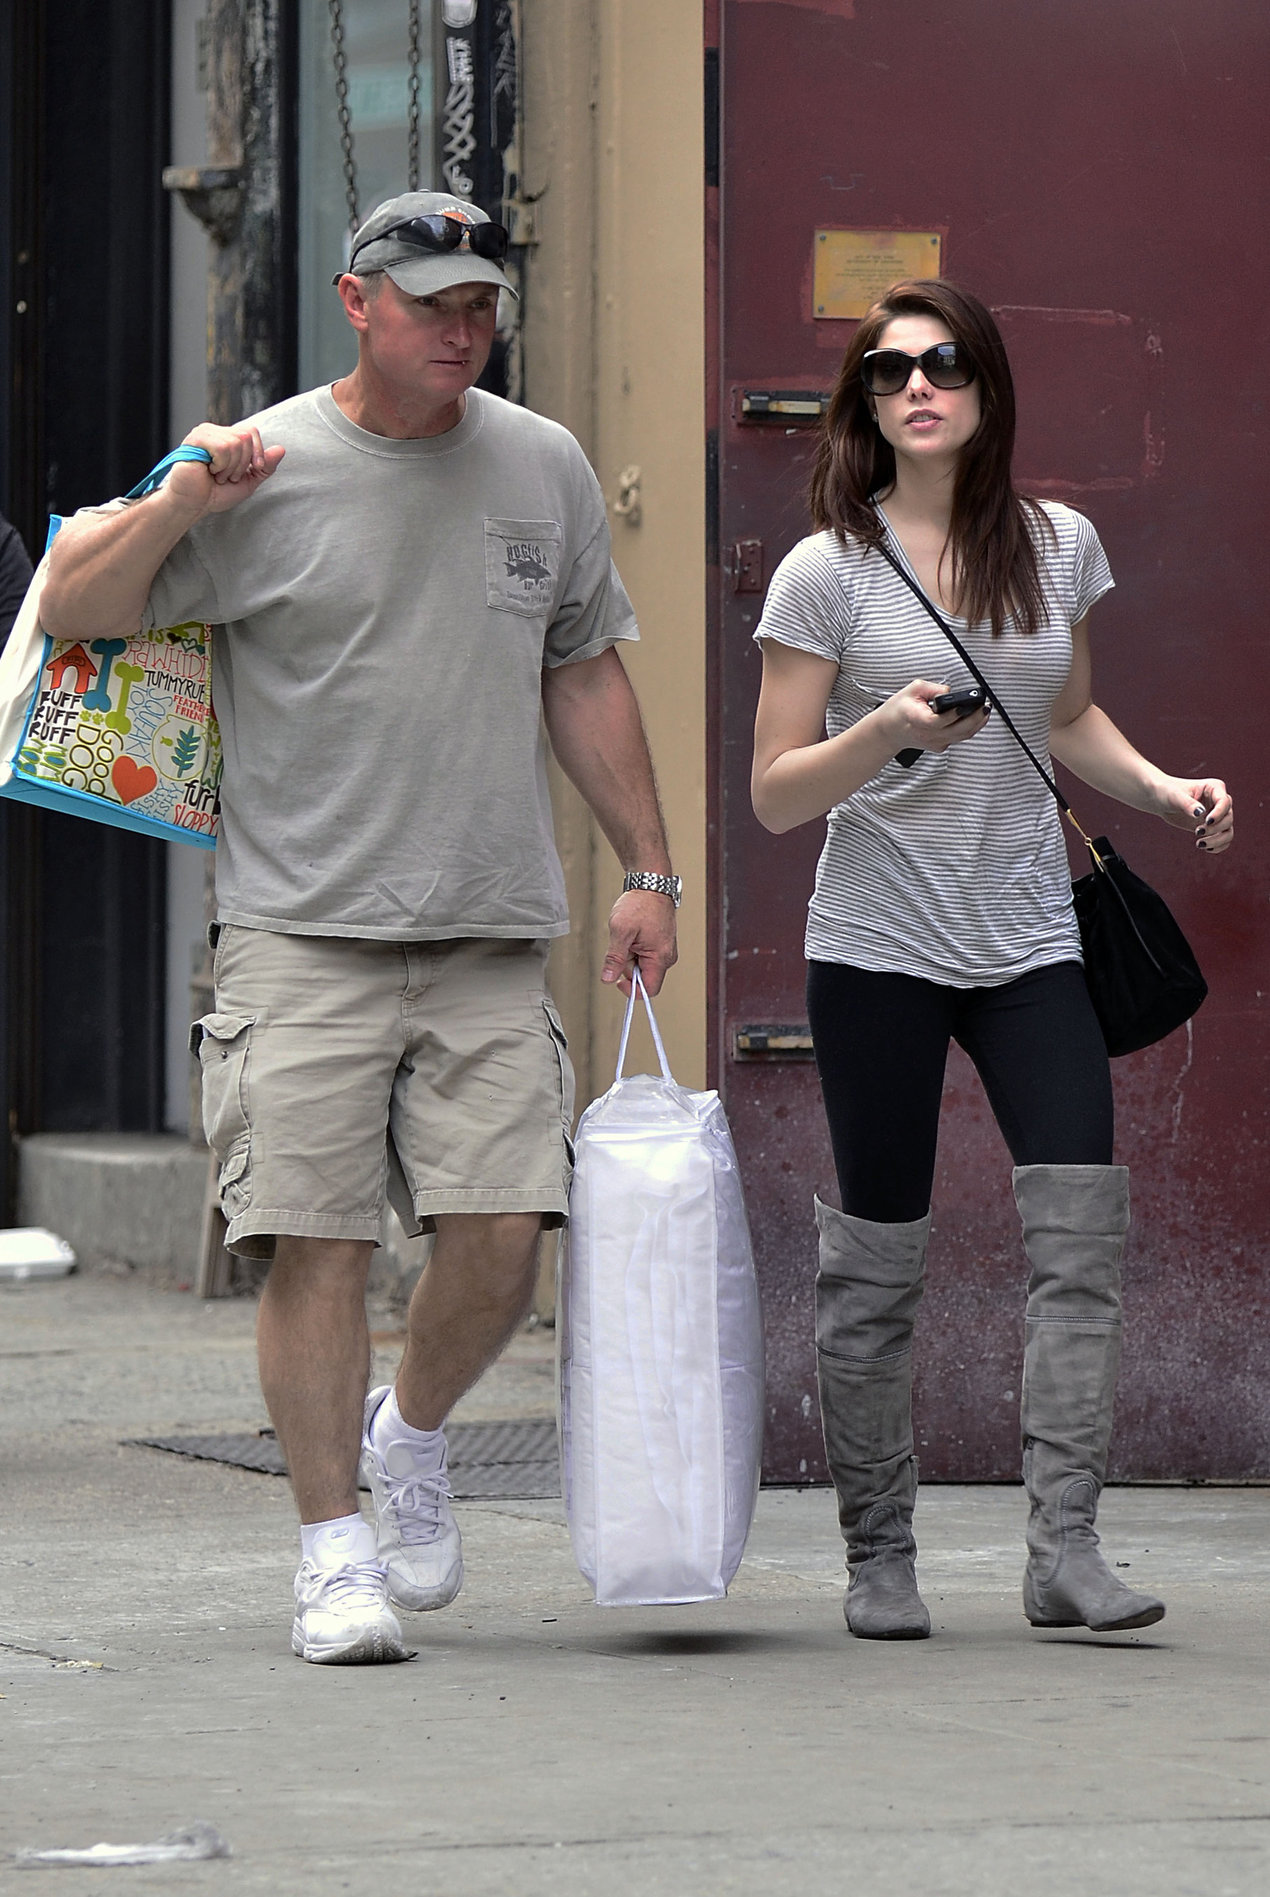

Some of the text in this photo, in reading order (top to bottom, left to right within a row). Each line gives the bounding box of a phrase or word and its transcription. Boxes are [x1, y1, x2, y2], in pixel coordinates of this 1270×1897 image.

[40, 689, 83, 709] RUFF
[34, 705, 79, 726] RUFF
[28, 721, 76, 744] RUFF
[62, 723, 101, 790] DOG
